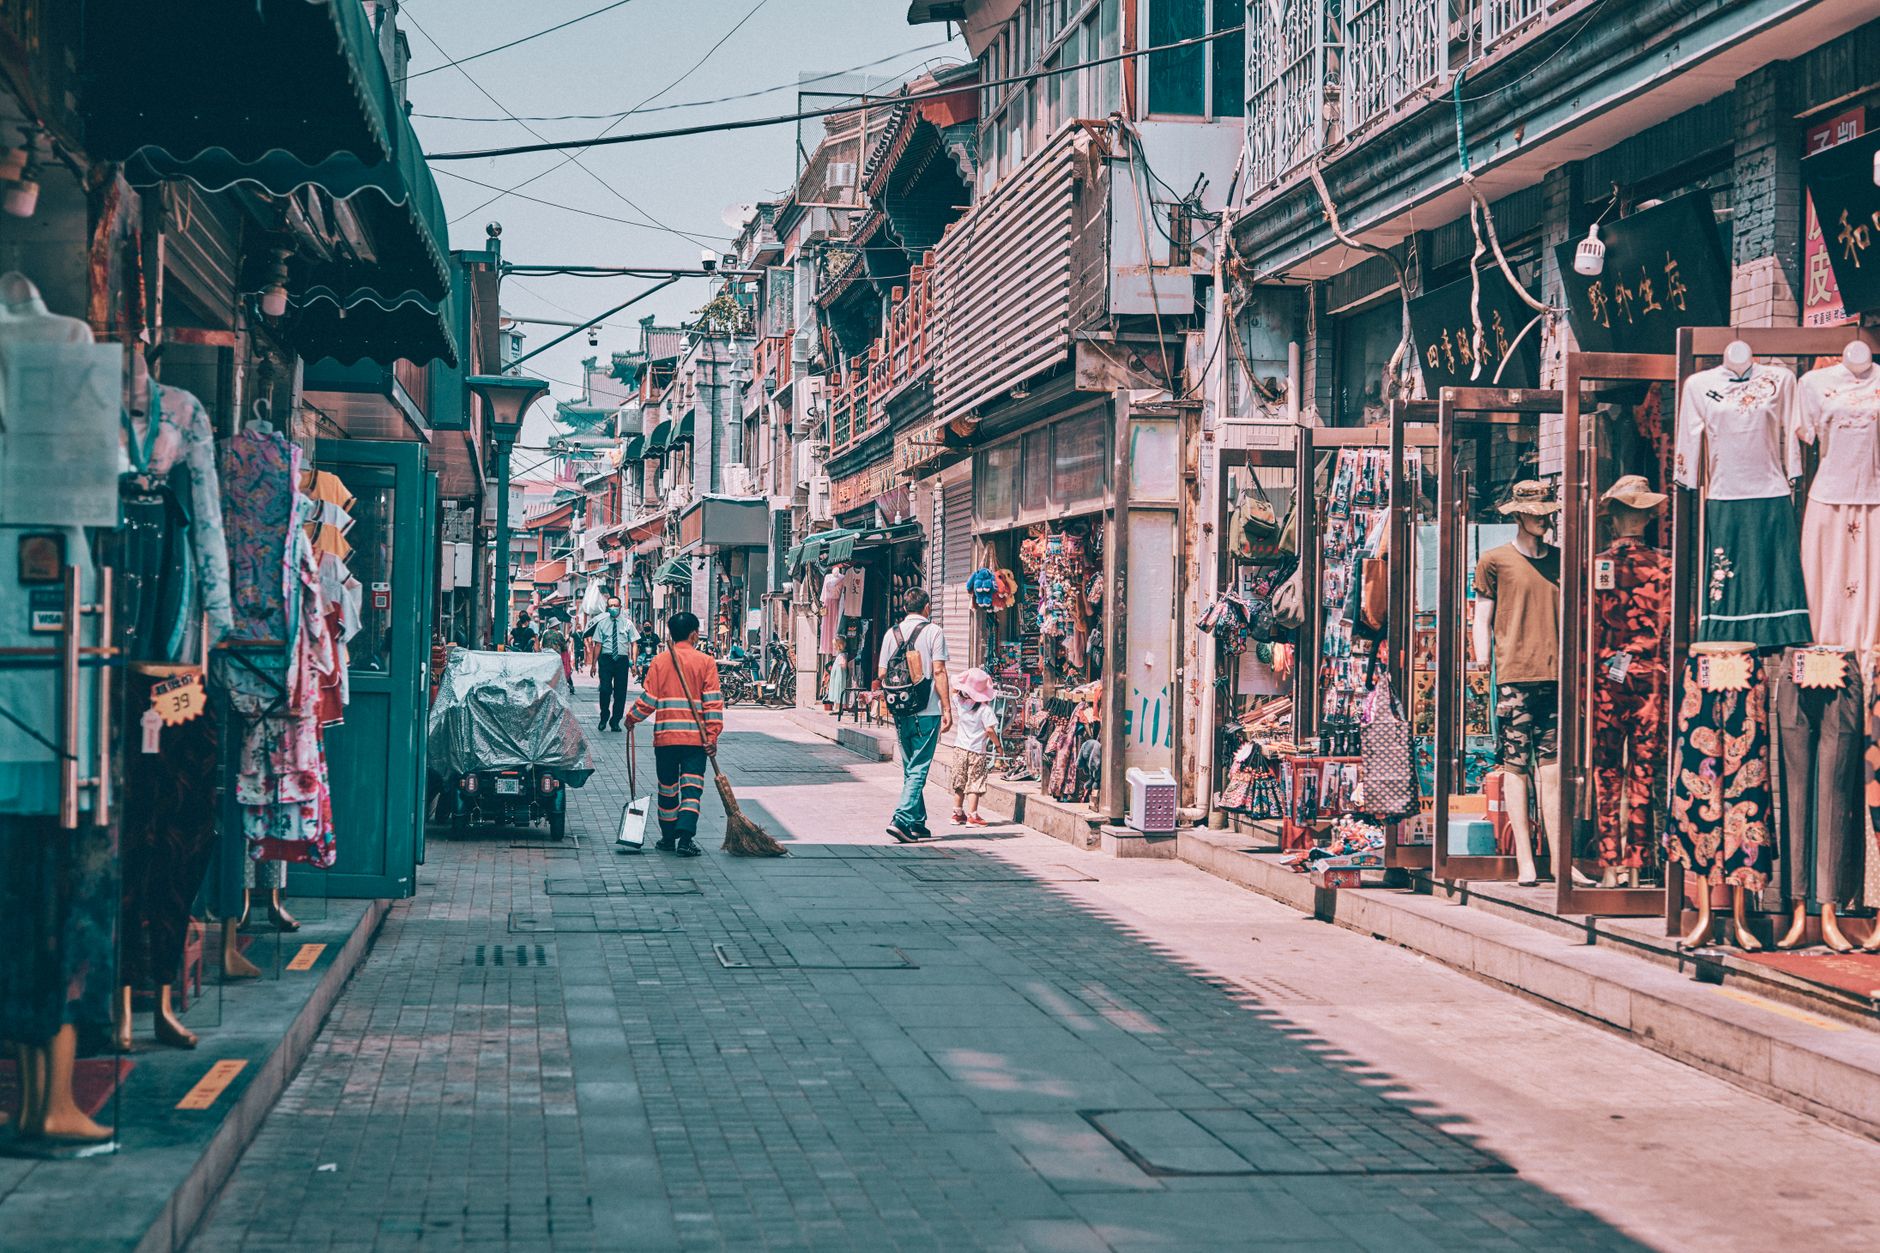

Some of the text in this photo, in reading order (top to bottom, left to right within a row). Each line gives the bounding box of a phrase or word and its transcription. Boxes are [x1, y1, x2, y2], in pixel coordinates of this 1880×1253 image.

[1588, 250, 1687, 328] 野外生存
[38, 613, 63, 624] VISA
[172, 693, 190, 713] 39
